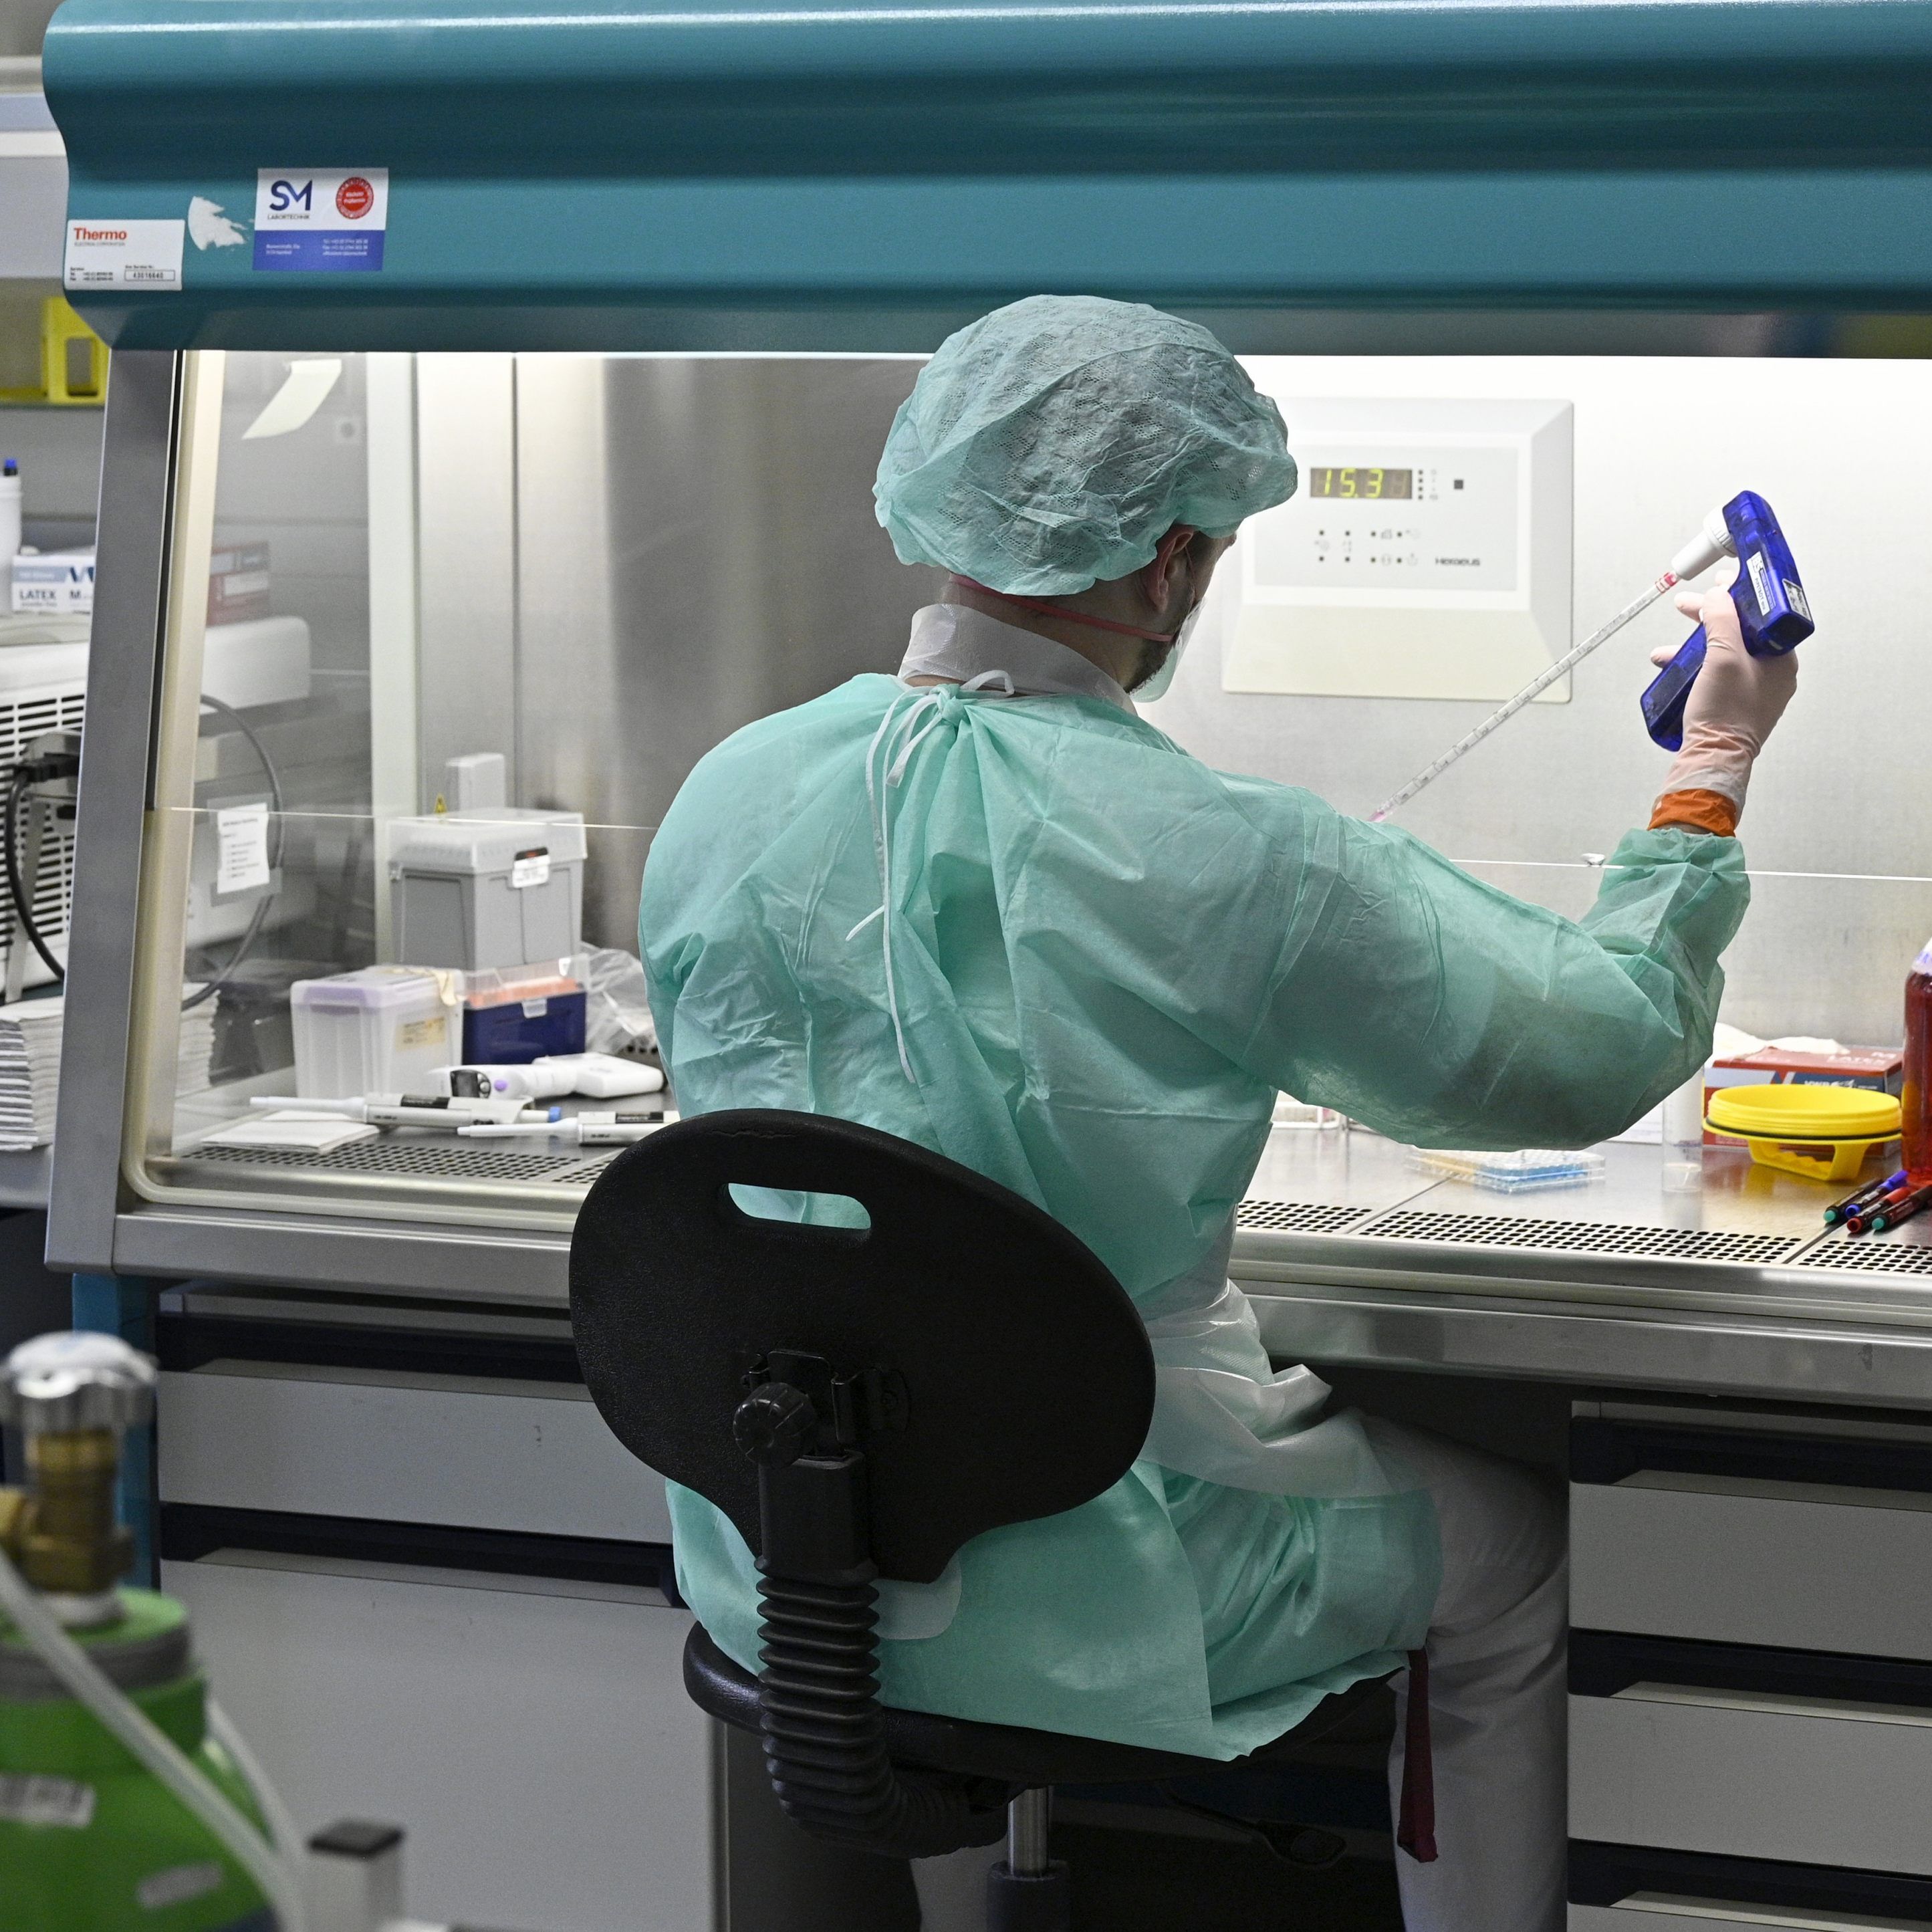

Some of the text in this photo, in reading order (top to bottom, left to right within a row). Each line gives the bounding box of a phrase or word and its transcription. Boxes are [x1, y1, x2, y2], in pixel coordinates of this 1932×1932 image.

[269, 179, 313, 211] SM
[74, 227, 127, 240] Thermo
[19, 590, 81, 600] LATEX M
